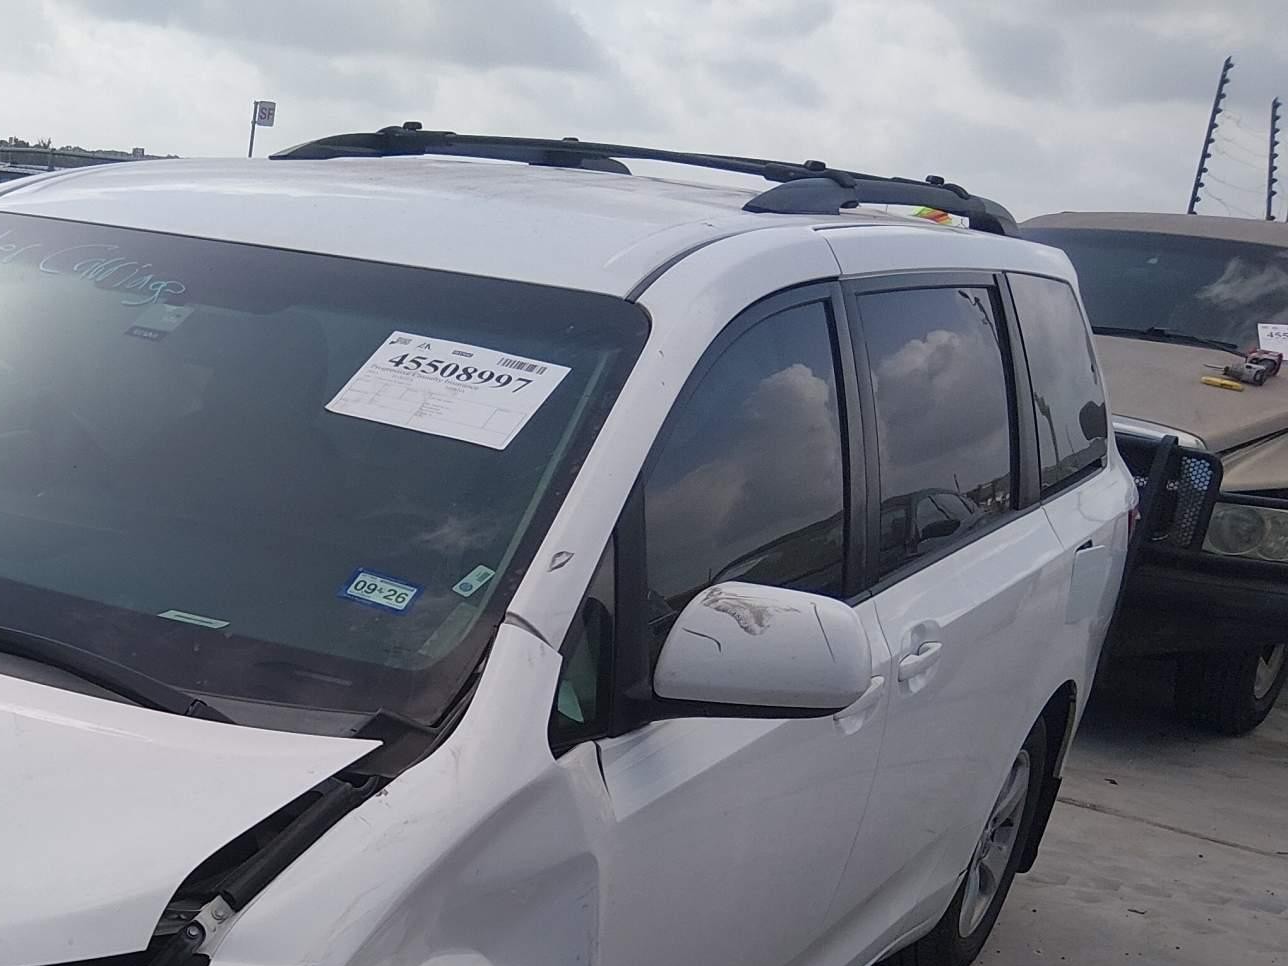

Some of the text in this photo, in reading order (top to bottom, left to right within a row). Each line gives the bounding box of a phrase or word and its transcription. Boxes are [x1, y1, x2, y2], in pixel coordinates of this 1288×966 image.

[259, 107, 275, 121] SF
[389, 353, 534, 393] 45508997
[353, 579, 378, 594] 09
[382, 588, 409, 604] 26
